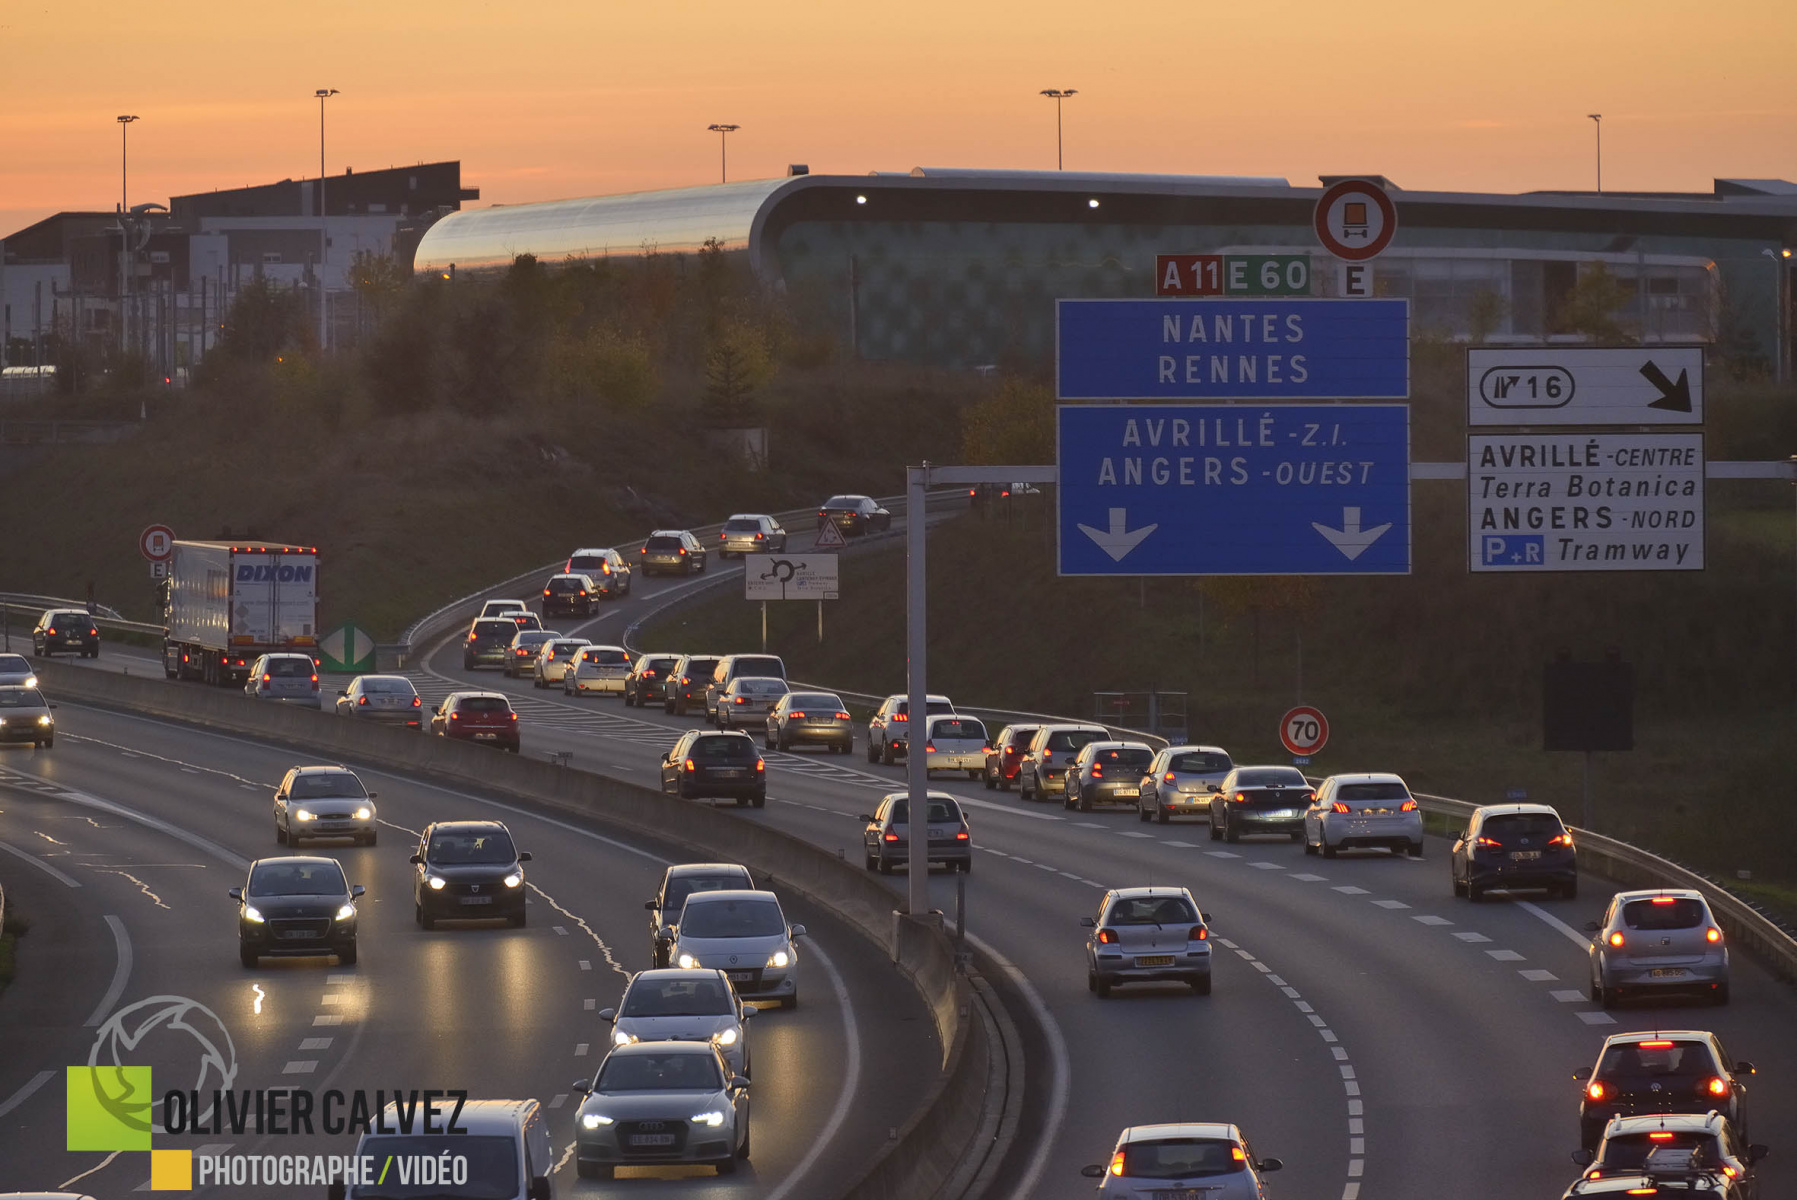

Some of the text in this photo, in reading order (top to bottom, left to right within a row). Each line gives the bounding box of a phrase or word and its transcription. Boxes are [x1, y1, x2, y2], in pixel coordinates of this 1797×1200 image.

[1346, 266, 1365, 295] E
[1163, 314, 1303, 343] NANTES
[1159, 355, 1308, 383] RENNES
[1528, 375, 1562, 399] 16
[1122, 412, 1275, 447] AVRILLÉ
[1480, 439, 1600, 468] AVRILLÉ
[1098, 457, 1249, 486] ANGERS
[1481, 475, 1695, 498] Terra Botanica
[1481, 507, 1612, 529] ANGERS
[1558, 538, 1689, 564] Tramway
[154, 564, 162, 576] E
[237, 565, 312, 582] DIXON
[1292, 721, 1319, 741] 70
